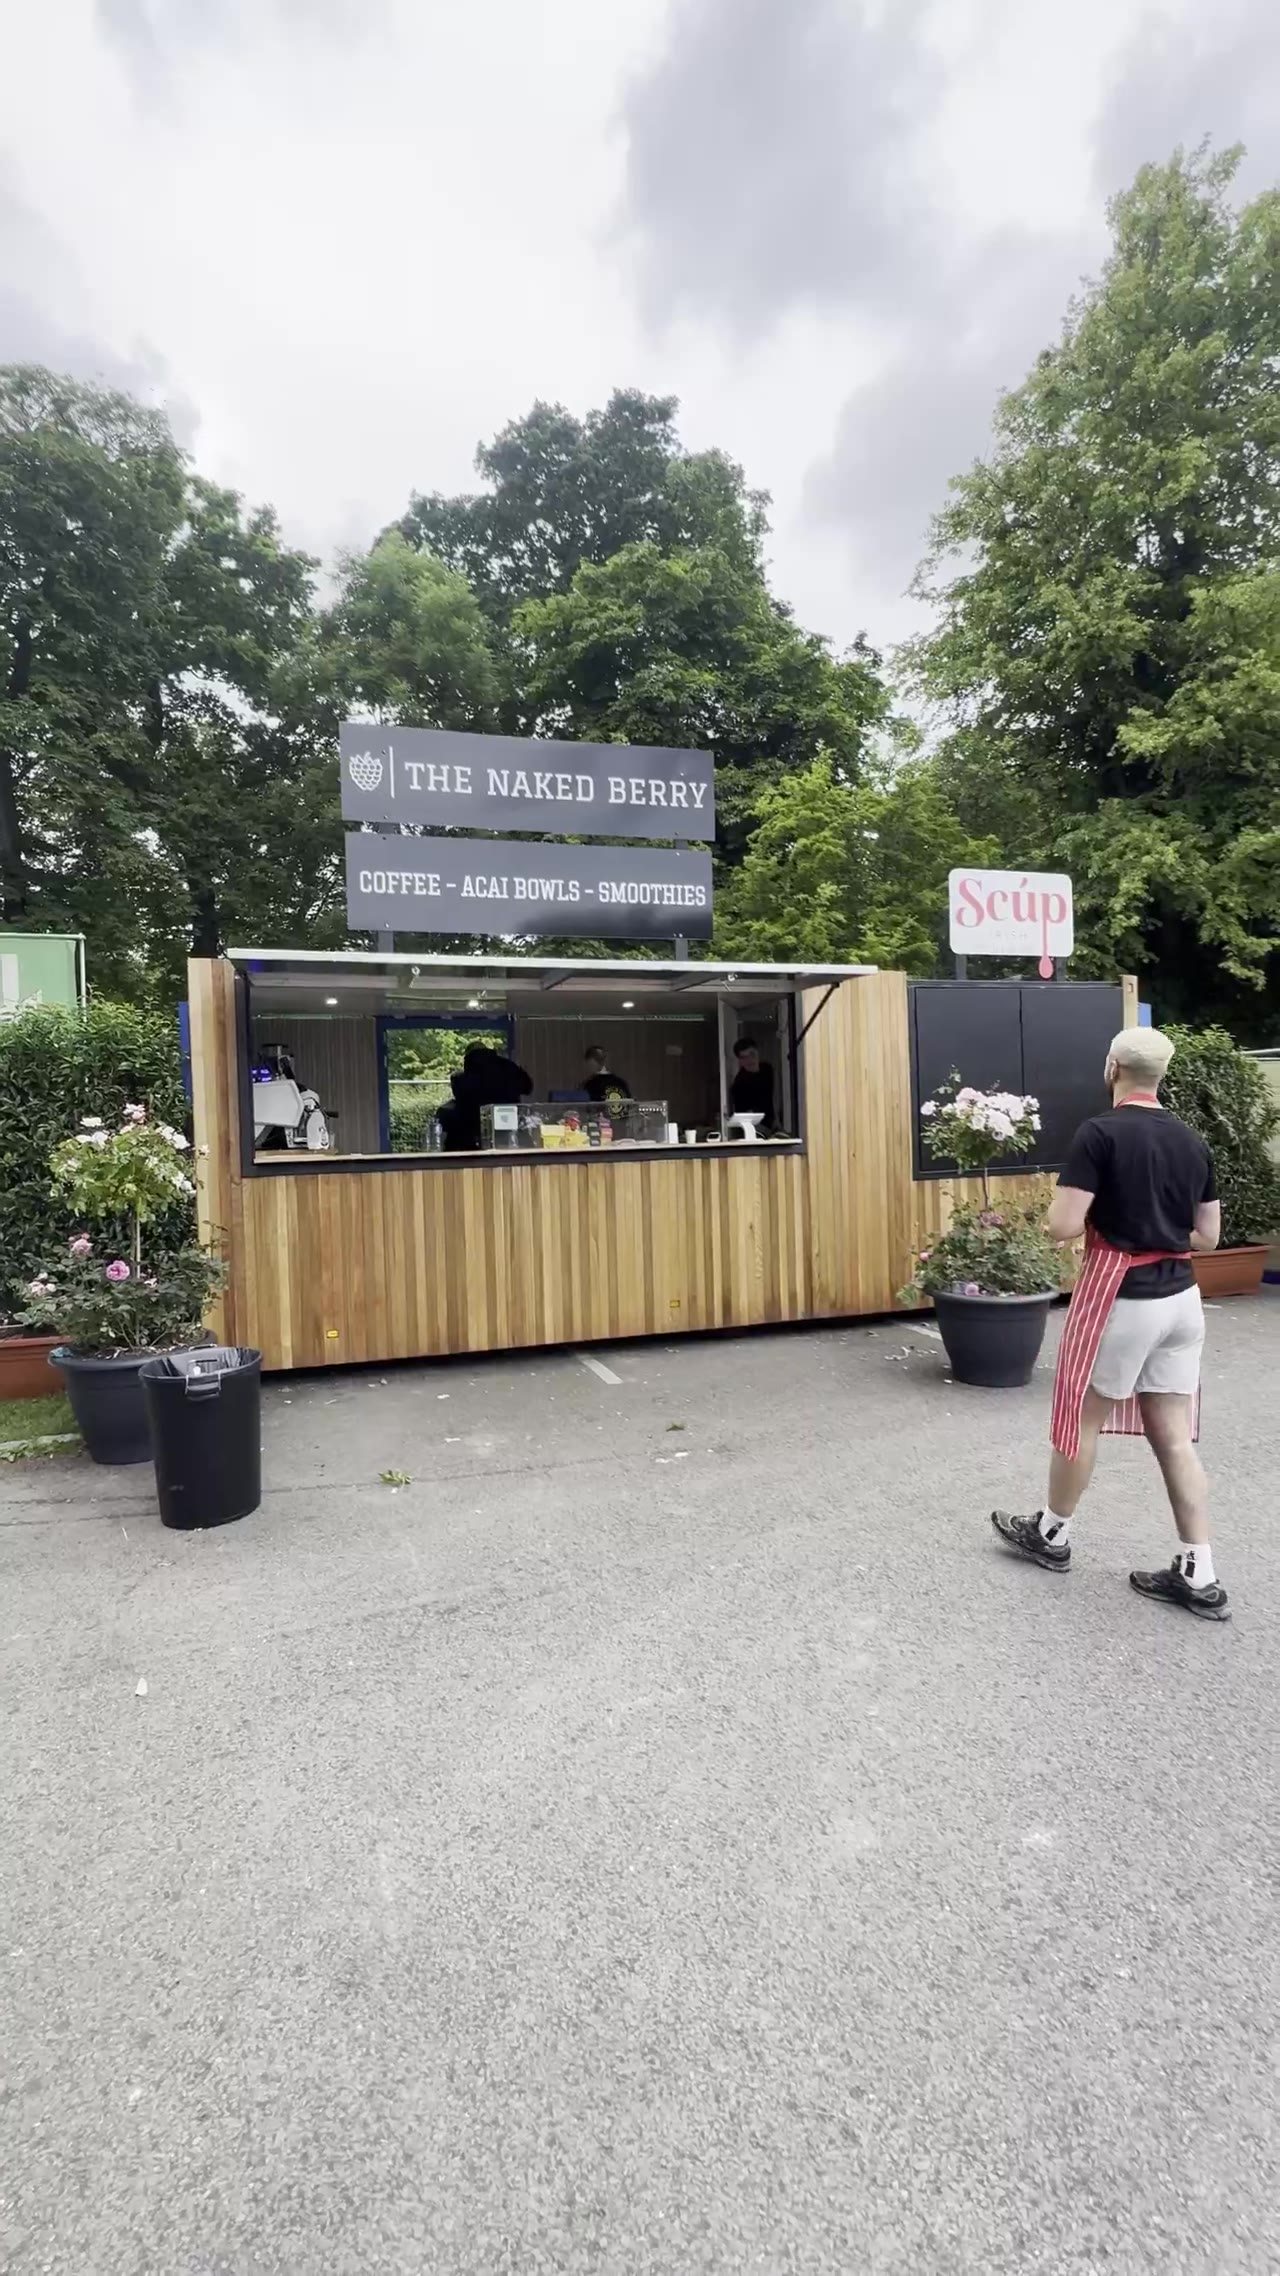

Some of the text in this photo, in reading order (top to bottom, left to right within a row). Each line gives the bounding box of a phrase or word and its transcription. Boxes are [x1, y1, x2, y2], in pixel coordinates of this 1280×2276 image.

[404, 762, 708, 809] THE NAKED BERRY
[359, 870, 441, 897] COFFEE
[461, 875, 509, 899] ACAI
[513, 877, 580, 902] BOWLS
[598, 882, 706, 907] SMOOTHIES
